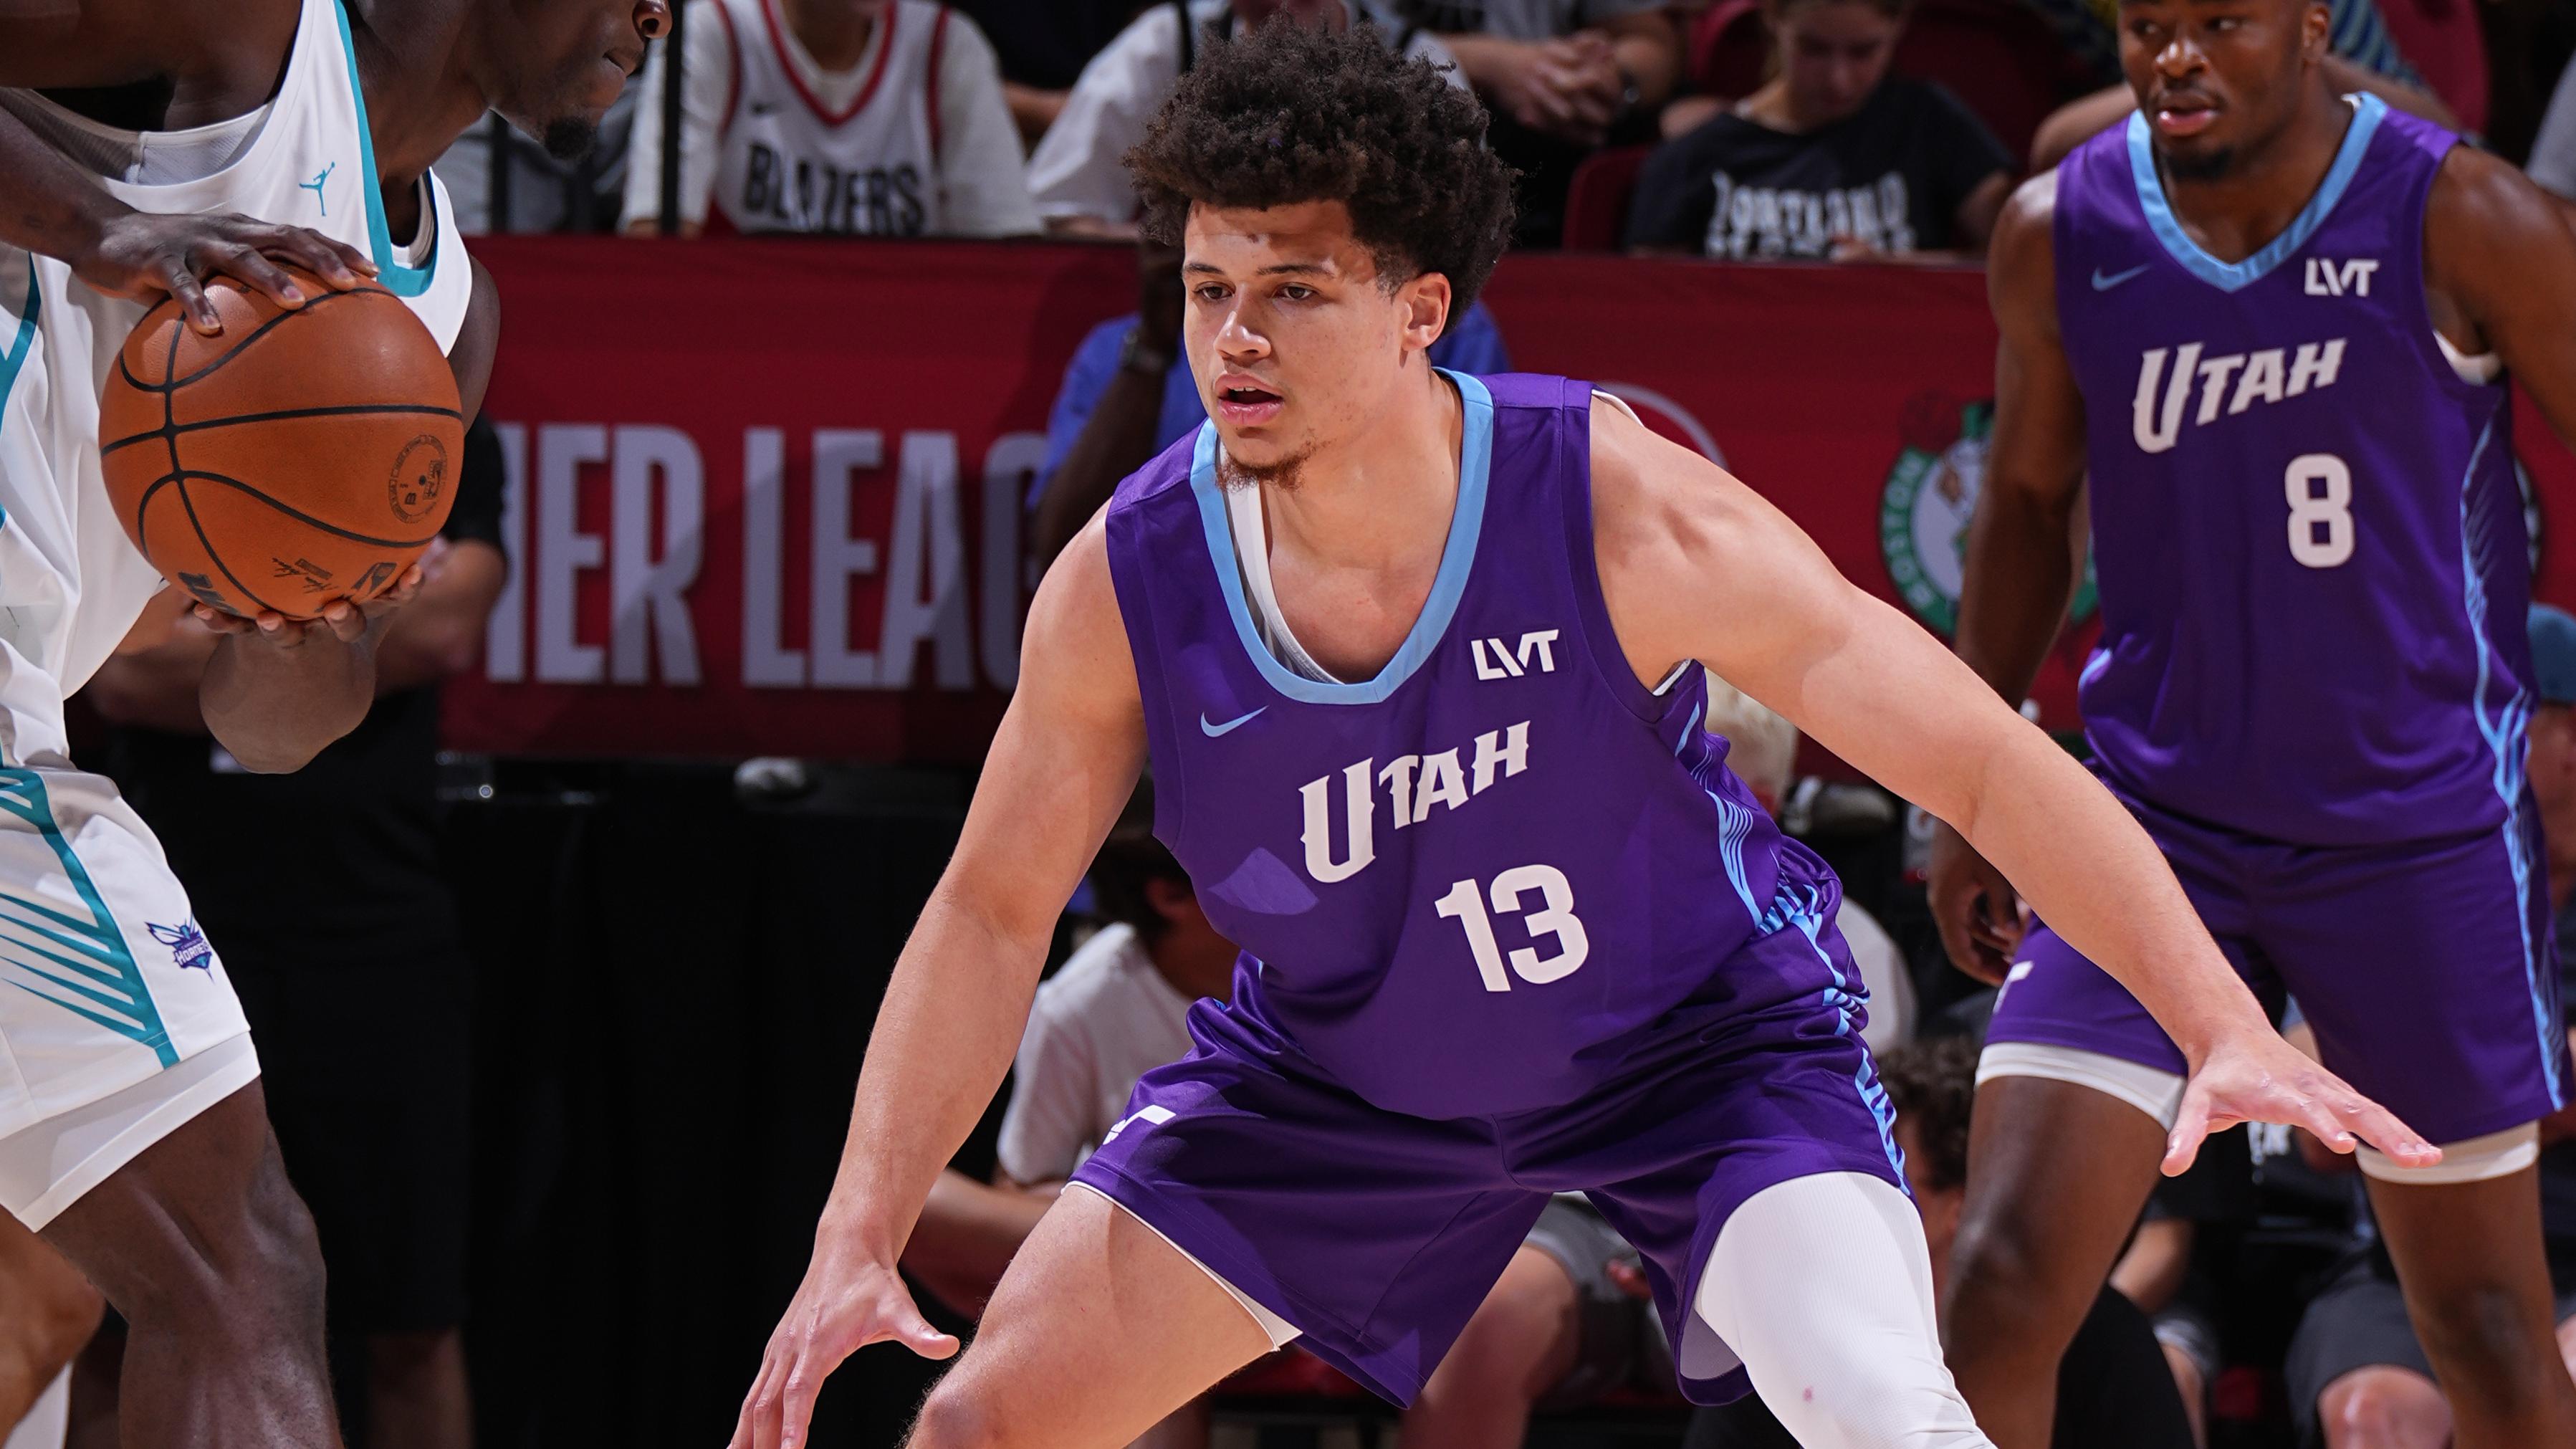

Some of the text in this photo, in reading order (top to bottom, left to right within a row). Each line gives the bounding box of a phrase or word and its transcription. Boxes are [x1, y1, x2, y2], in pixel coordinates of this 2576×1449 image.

[2304, 259, 2379, 297] LVT
[2132, 338, 2347, 454] UTAH
[487, 421, 705, 686] ER
[2284, 454, 2354, 569] 8
[1470, 628, 1559, 682] LVT
[1297, 719, 1531, 884] UTAH
[1433, 864, 1590, 993] 13
